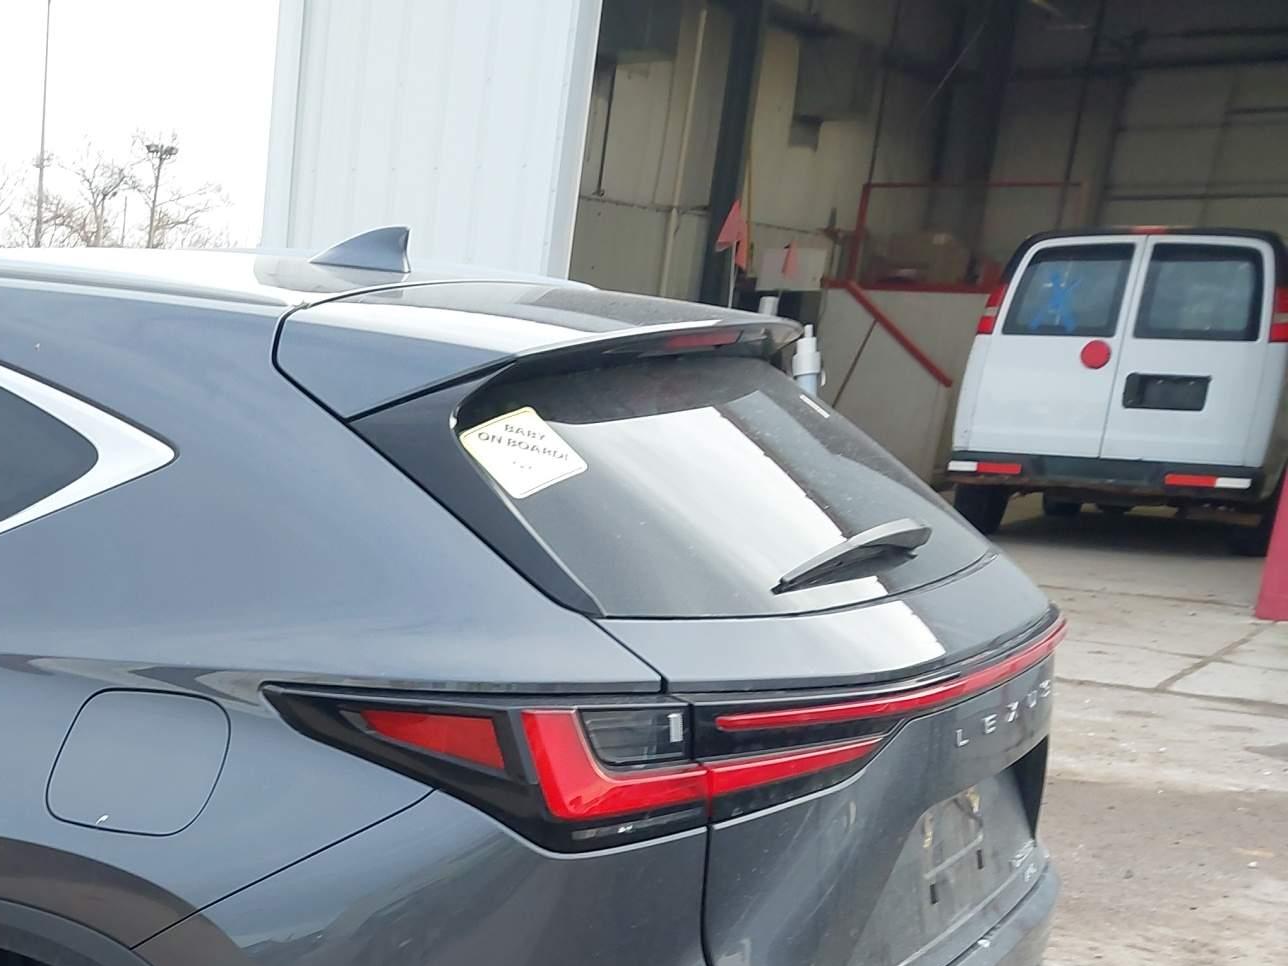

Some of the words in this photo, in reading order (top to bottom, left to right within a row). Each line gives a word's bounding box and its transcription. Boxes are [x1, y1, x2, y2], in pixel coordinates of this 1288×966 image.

[477, 432, 502, 444] ON
[504, 424, 545, 440] BABY
[956, 680, 1051, 748] LEXUS
